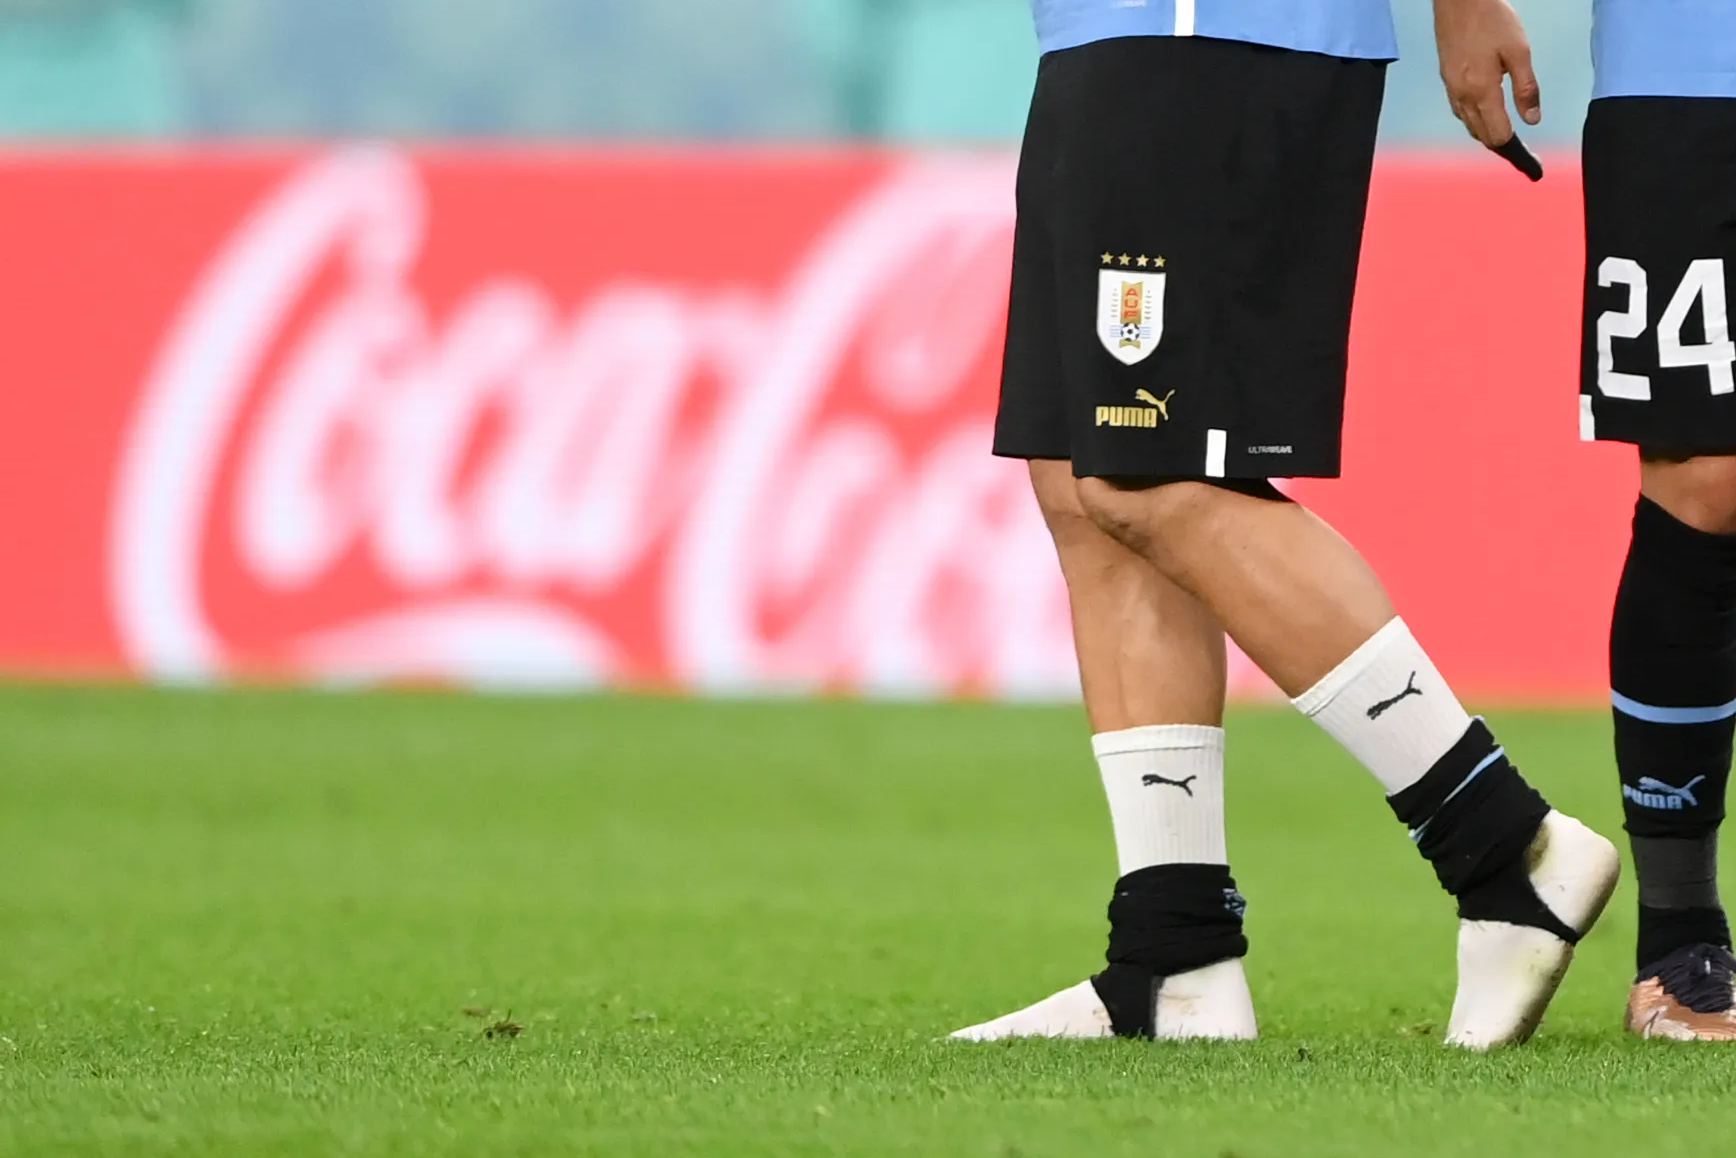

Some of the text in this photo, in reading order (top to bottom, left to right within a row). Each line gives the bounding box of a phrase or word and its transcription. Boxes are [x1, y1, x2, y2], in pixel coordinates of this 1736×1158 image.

[1597, 256, 1736, 401] 24
[108, 142, 1078, 700] Coca-Co
[1095, 406, 1157, 428] PUMA
[1623, 783, 1683, 810] PUMA
